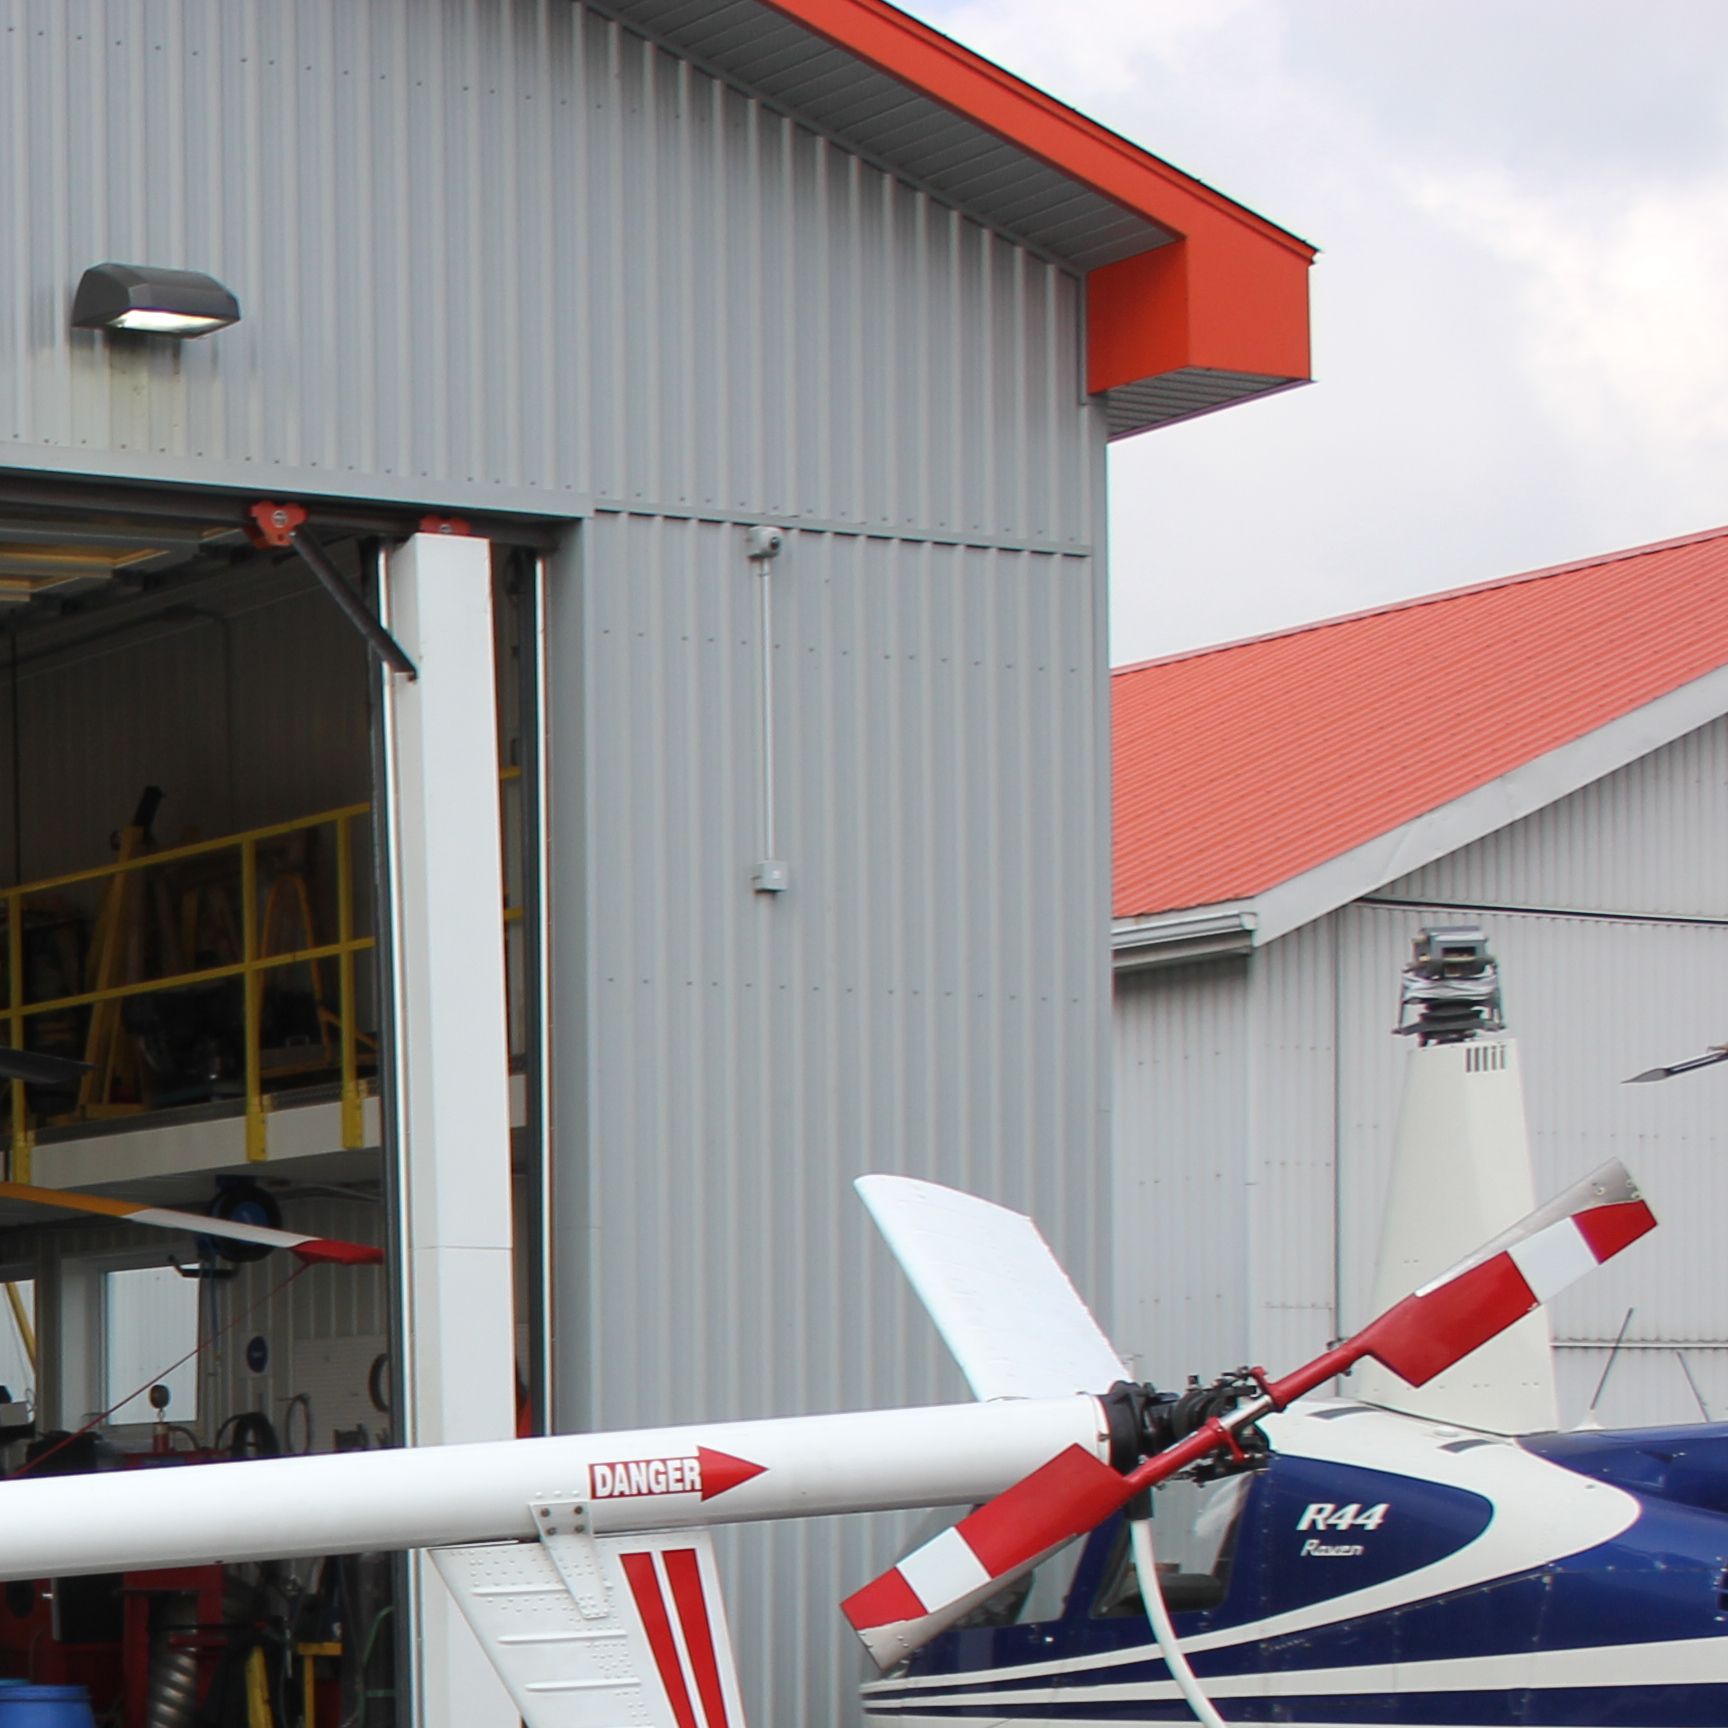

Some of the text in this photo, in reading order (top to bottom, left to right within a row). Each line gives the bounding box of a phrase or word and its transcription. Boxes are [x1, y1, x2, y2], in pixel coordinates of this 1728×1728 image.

[593, 1458, 702, 1498] DANGER
[1296, 1503, 1391, 1531] R44
[1300, 1539, 1365, 1557] Raven
